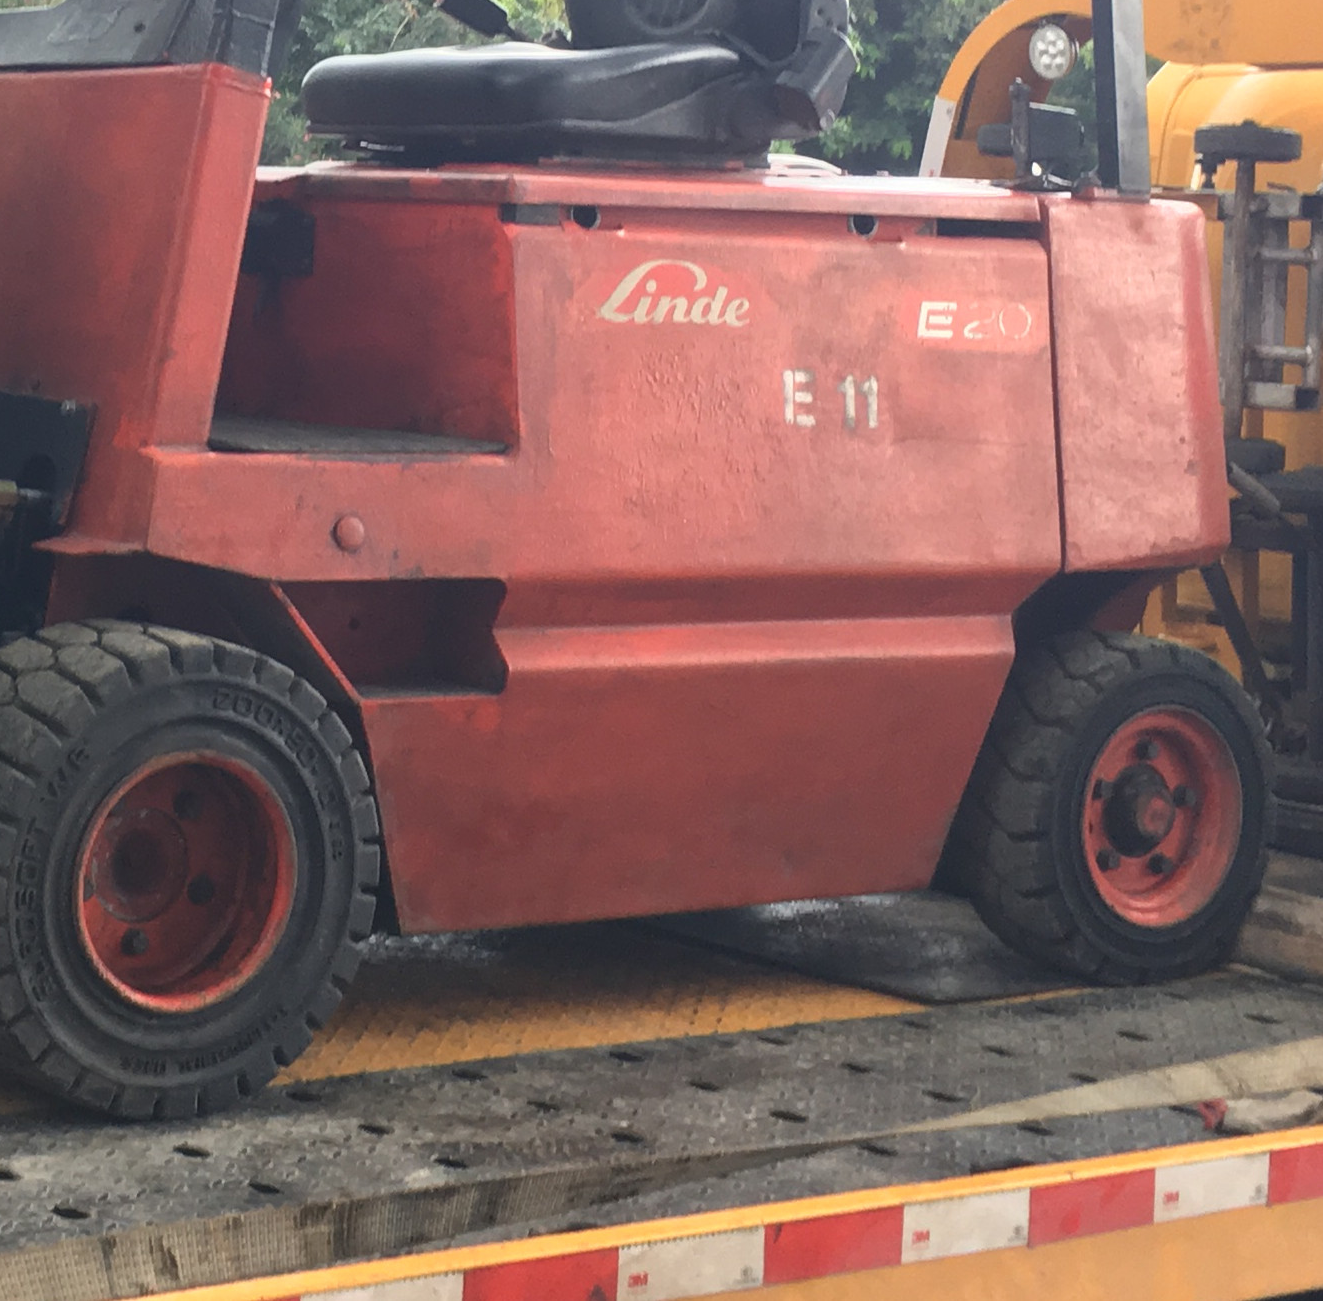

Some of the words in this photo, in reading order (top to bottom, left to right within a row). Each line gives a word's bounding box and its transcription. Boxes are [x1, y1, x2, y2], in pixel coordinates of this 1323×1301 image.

[596, 259, 750, 327] Linde
[782, 369, 816, 426] E
[838, 375, 878, 429] 11
